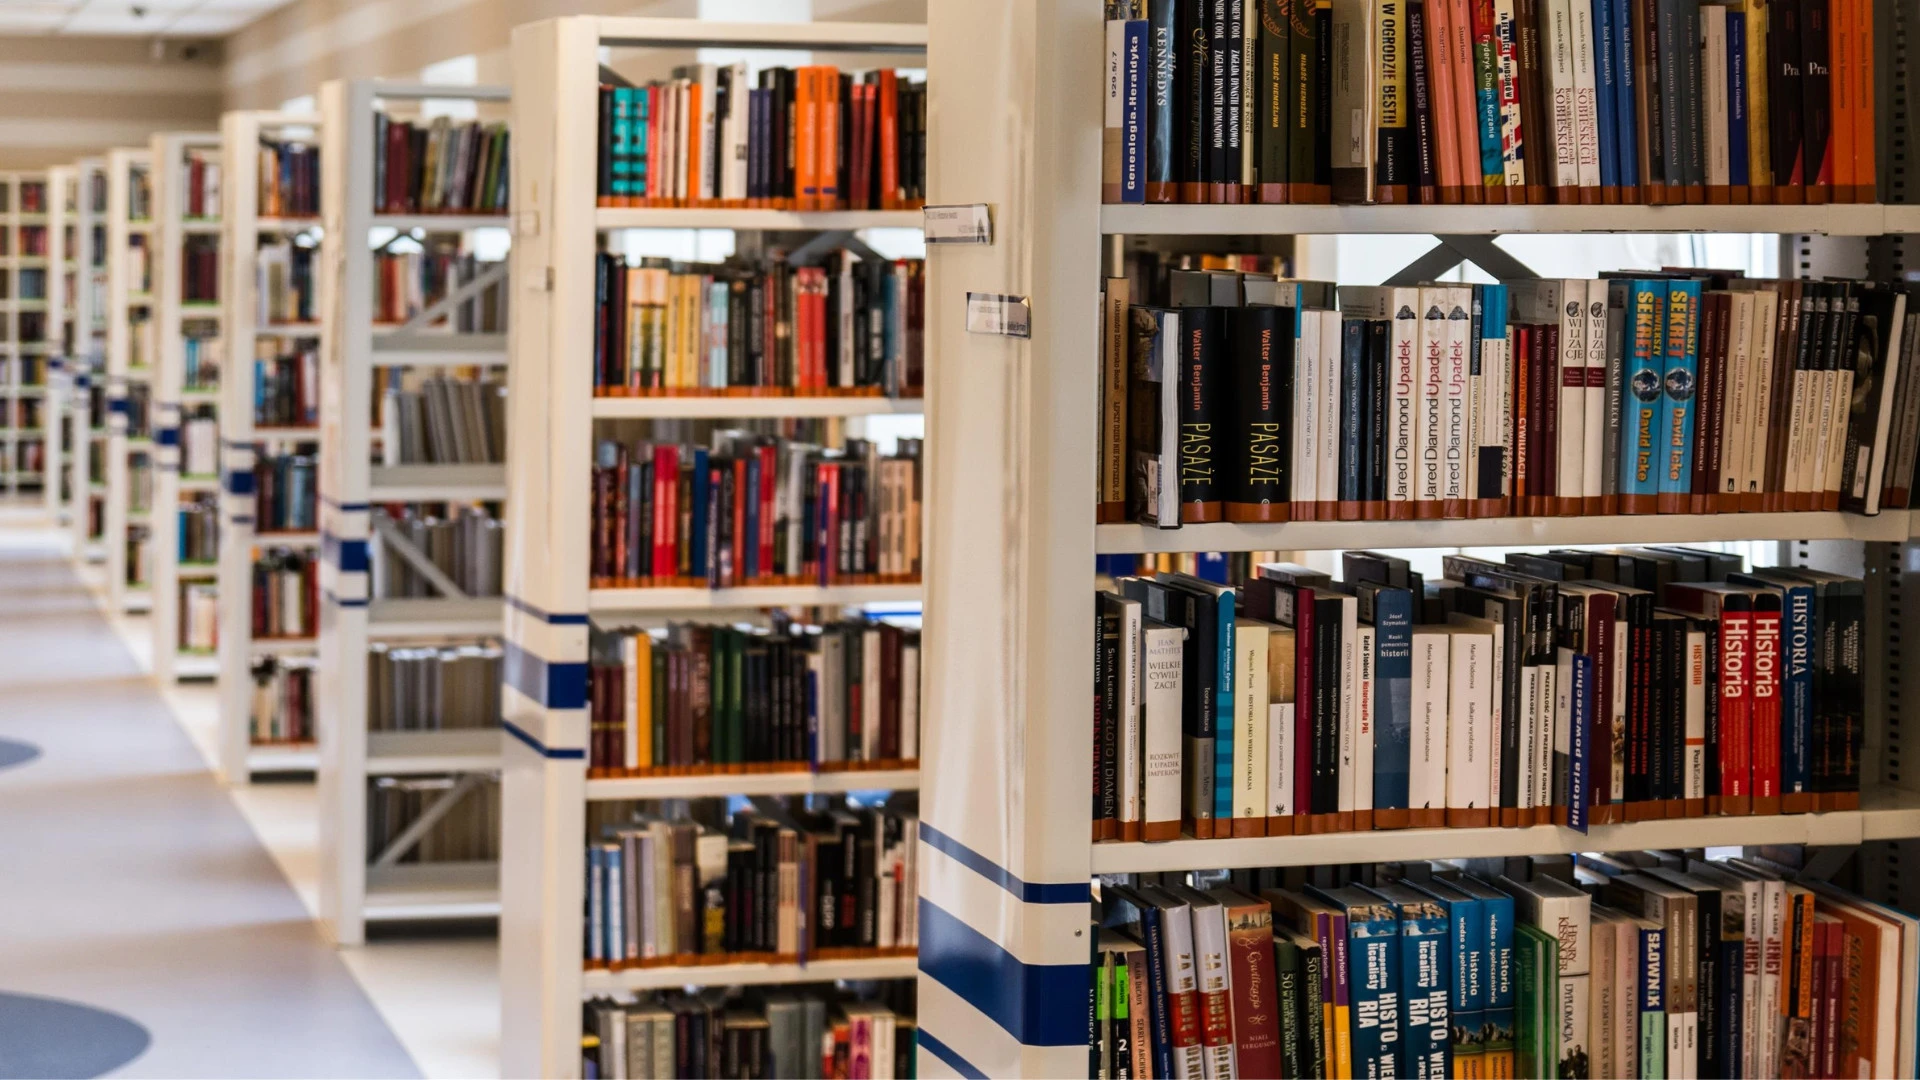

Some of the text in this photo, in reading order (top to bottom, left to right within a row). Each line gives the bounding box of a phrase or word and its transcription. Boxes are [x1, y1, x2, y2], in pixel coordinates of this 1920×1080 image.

[1157, 27, 1166, 106] KENNEDYS
[1167, 52, 1176, 80] The
[1382, 3, 1397, 123] W OGRODZIE BESTII
[1438, 26, 1447, 64] Stuartowie
[1458, 26, 1467, 63] Stuartowie
[1500, 12, 1512, 98] TAJEMNICE WINDSORÓW
[1522, 28, 1530, 69] Burbonowie
[1602, 41, 1612, 85] Bonapartych
[1624, 43, 1632, 86] Bonapartych
[1214, 0, 1224, 148] NDREW COOK ZAGŁADA DYNASTII ROMANOWÓW
[1230, 0, 1240, 148] NDREW COOK ZAGŁADA DYNASTII ROMANOWÓW
[1482, 34, 1496, 138] Fryderyk Chopin. Korzenie
[1127, 36, 1139, 189] Genealogia.Heraldyka
[1564, 88, 1572, 116] Rozkwit
[1555, 88, 1568, 165] SOBIESKICH
[1565, 121, 1574, 146] upadek
[1577, 88, 1591, 165] SOBIESKICH
[1588, 121, 1596, 146] upadek
[1568, 319, 1582, 327] WI
[1569, 340, 1581, 348] ZA
[1570, 329, 1580, 338] LI
[1593, 320, 1605, 328] WI
[1593, 340, 1604, 348] ZA
[1594, 330, 1603, 338] LI
[1635, 291, 1653, 359] SEKRET
[1668, 291, 1687, 359] SEKRET
[1192, 329, 1203, 410] Walter Benjamin
[1260, 329, 1271, 410] Walter Benjamin
[1566, 350, 1583, 360] CJE
[1590, 351, 1605, 360] CJE
[1611, 390, 1619, 427] HALECKI
[1796, 372, 1804, 403] GRANICE
[1821, 372, 1833, 436] GRANICE HISTORII
[1395, 340, 1412, 501] Jared Diamond Upadek
[1424, 340, 1442, 501] Jared Diamond Upadek
[1447, 340, 1465, 500] Jared Diamond Upadek
[1793, 406, 1801, 436] HISTORII
[1808, 398, 1816, 423] HISTORII
[1183, 423, 1215, 485] PASAŻE
[1250, 423, 1282, 485] PASAŻE
[1518, 418, 1526, 479] CYWILIZACJE
[1638, 409, 1652, 481] David Icke
[1670, 408, 1685, 480] David Icke
[1793, 595, 1807, 675] HISTORIA
[1362, 653, 1370, 679] Stobiecki
[1693, 645, 1702, 685] HISTORIA
[1725, 619, 1748, 697] Historia
[1756, 619, 1778, 697] Historia
[1572, 660, 1584, 826] Historia powszechna
[1307, 958, 1316, 972] 50
[1338, 939, 1346, 984] repetytorium
[1367, 943, 1378, 989] licealisty
[1379, 943, 1387, 988] Kompendium
[1418, 941, 1429, 987] licealisty
[1559, 917, 1568, 971] KISSINGER
[1568, 925, 1577, 962] HENRY
[1248, 951, 1262, 1009] Cywilizacja
[1282, 973, 1293, 988] 50
[1470, 951, 1479, 996] historia
[1501, 949, 1509, 992] historia
[1359, 1001, 1378, 1028] RIA
[1380, 993, 1397, 1042] HISTO
[1410, 999, 1429, 1026] RIA
[1430, 991, 1447, 1040] HISTO
[1562, 984, 1573, 1043] DYPLOMACJA
[1119, 1039, 1127, 1051] 2
[1602, 1047, 1609, 1059] XX
[1626, 1045, 1633, 1057] XX
